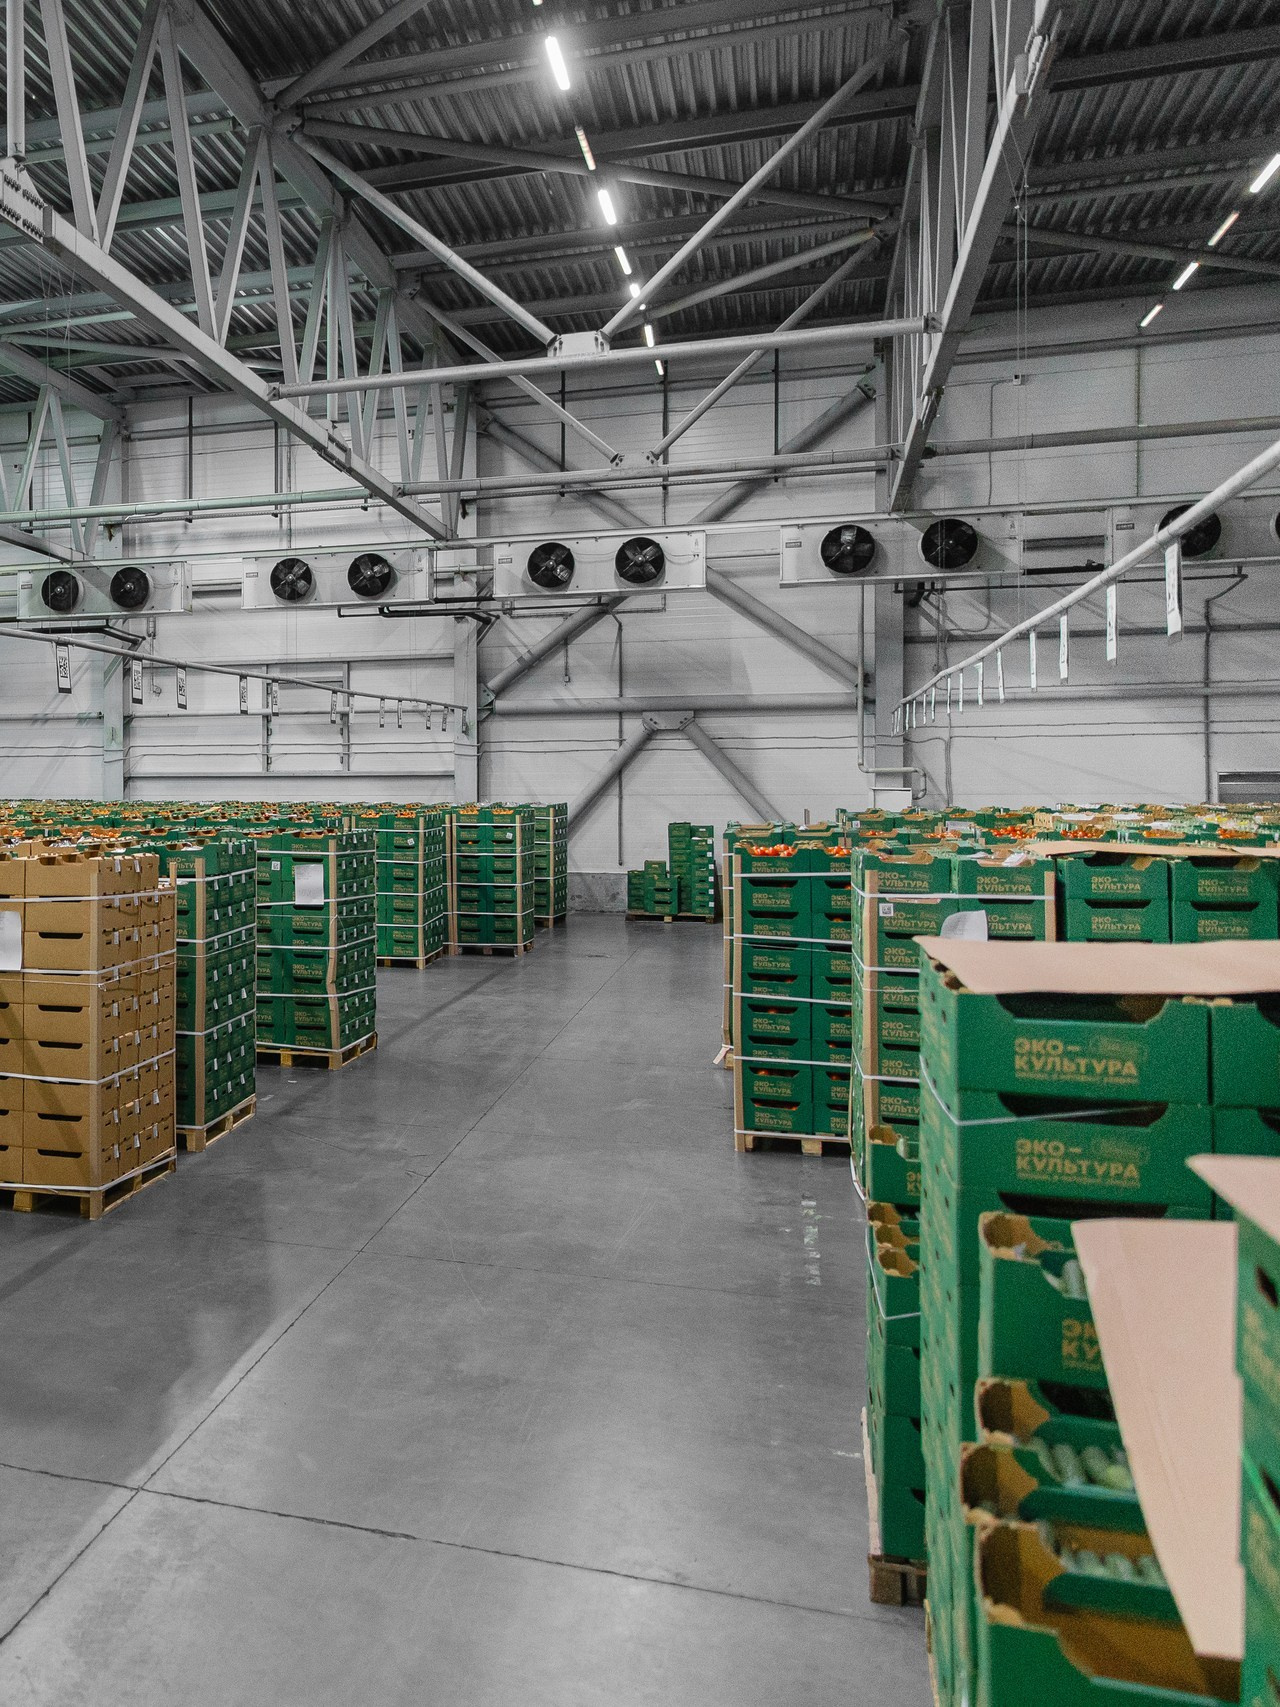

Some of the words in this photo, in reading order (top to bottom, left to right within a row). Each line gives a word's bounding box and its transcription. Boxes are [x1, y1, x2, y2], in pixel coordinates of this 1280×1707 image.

[884, 920, 937, 928] КУЛЬТУРА
[1015, 1038, 1081, 1054] ЭКО-
[1015, 1055, 1137, 1075] КУЛЬТУРА
[1016, 1139, 1081, 1156] ЭКО-
[1016, 1156, 1138, 1178] КУЛЬТУРА
